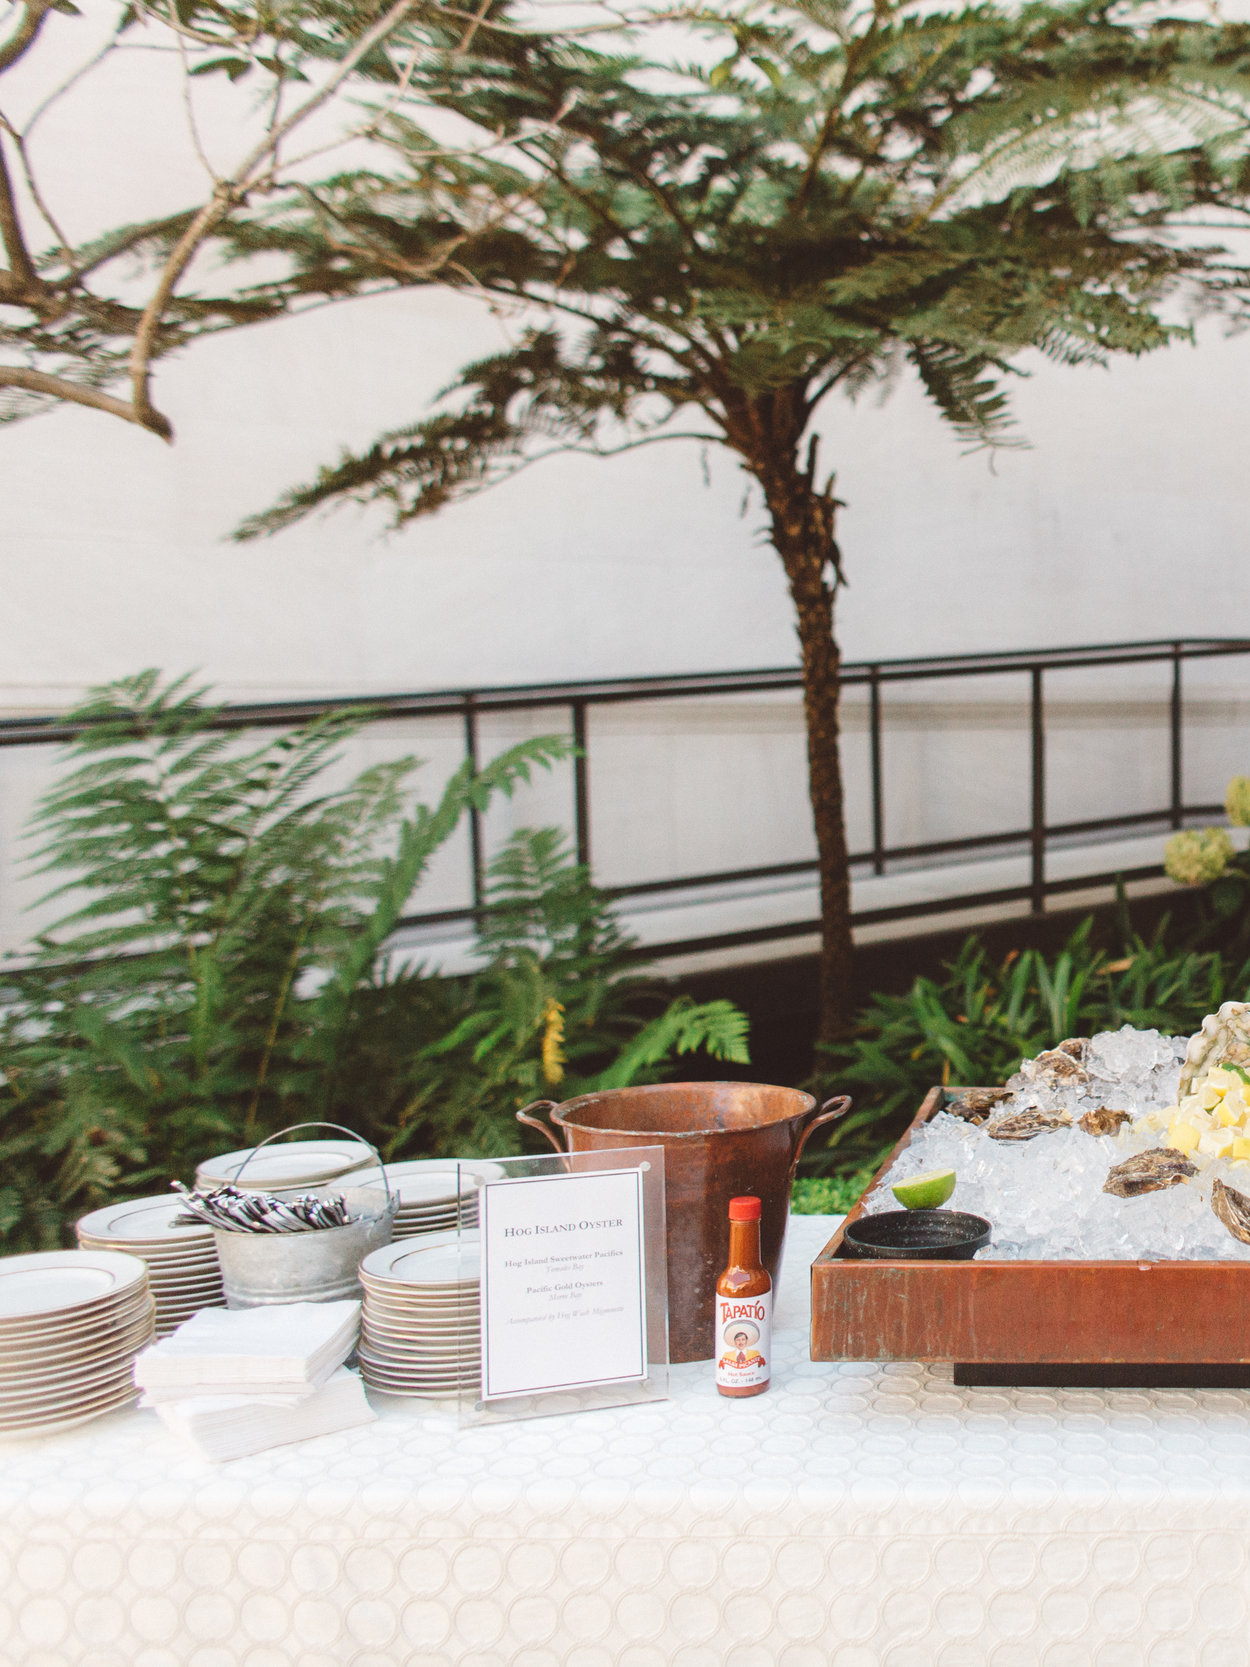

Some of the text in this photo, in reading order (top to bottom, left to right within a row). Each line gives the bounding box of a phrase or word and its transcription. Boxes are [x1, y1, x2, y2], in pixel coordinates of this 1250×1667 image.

[504, 1219, 623, 1238] HOG ISLAND OYSTER
[504, 1260, 522, 1269] Hog
[524, 1256, 548, 1266] Island
[526, 1280, 603, 1294] Pacific Gold Oysters
